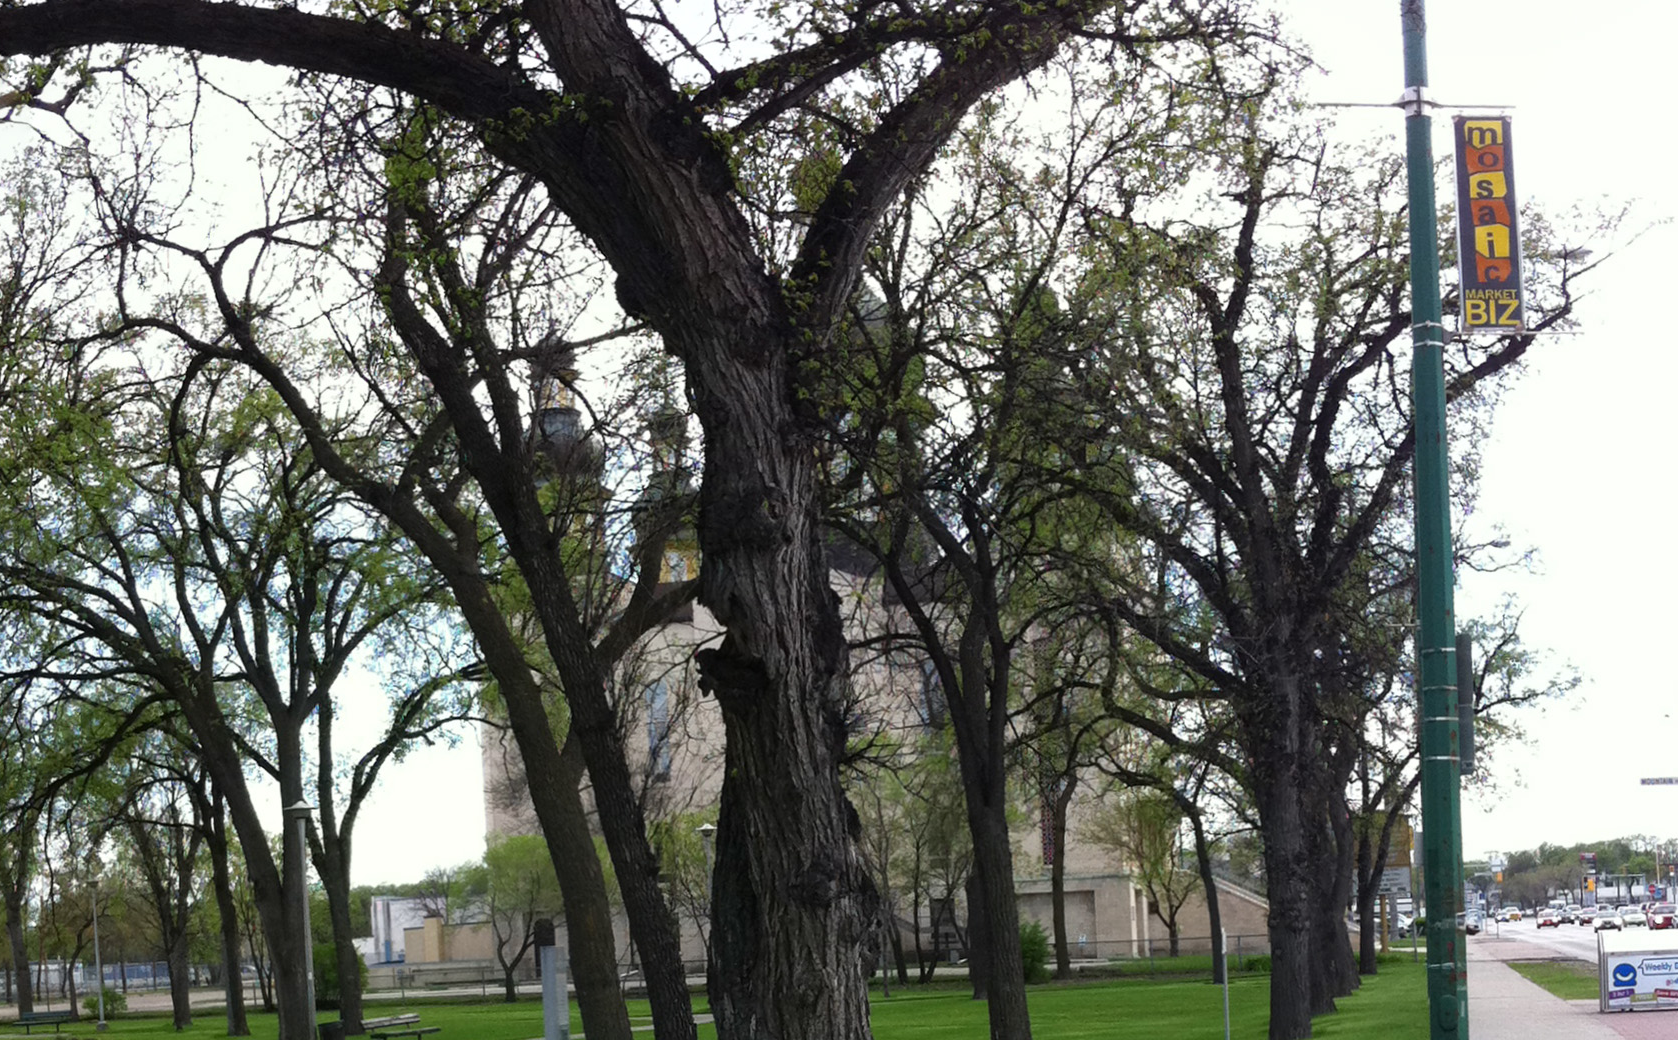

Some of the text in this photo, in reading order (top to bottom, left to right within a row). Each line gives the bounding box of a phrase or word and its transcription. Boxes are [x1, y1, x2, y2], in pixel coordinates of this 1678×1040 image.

[1467, 126, 1501, 283] mosaic
[1466, 289, 1518, 300] MARKET
[1466, 299, 1521, 325] BIZ
[1644, 962, 1673, 972] Weekly
